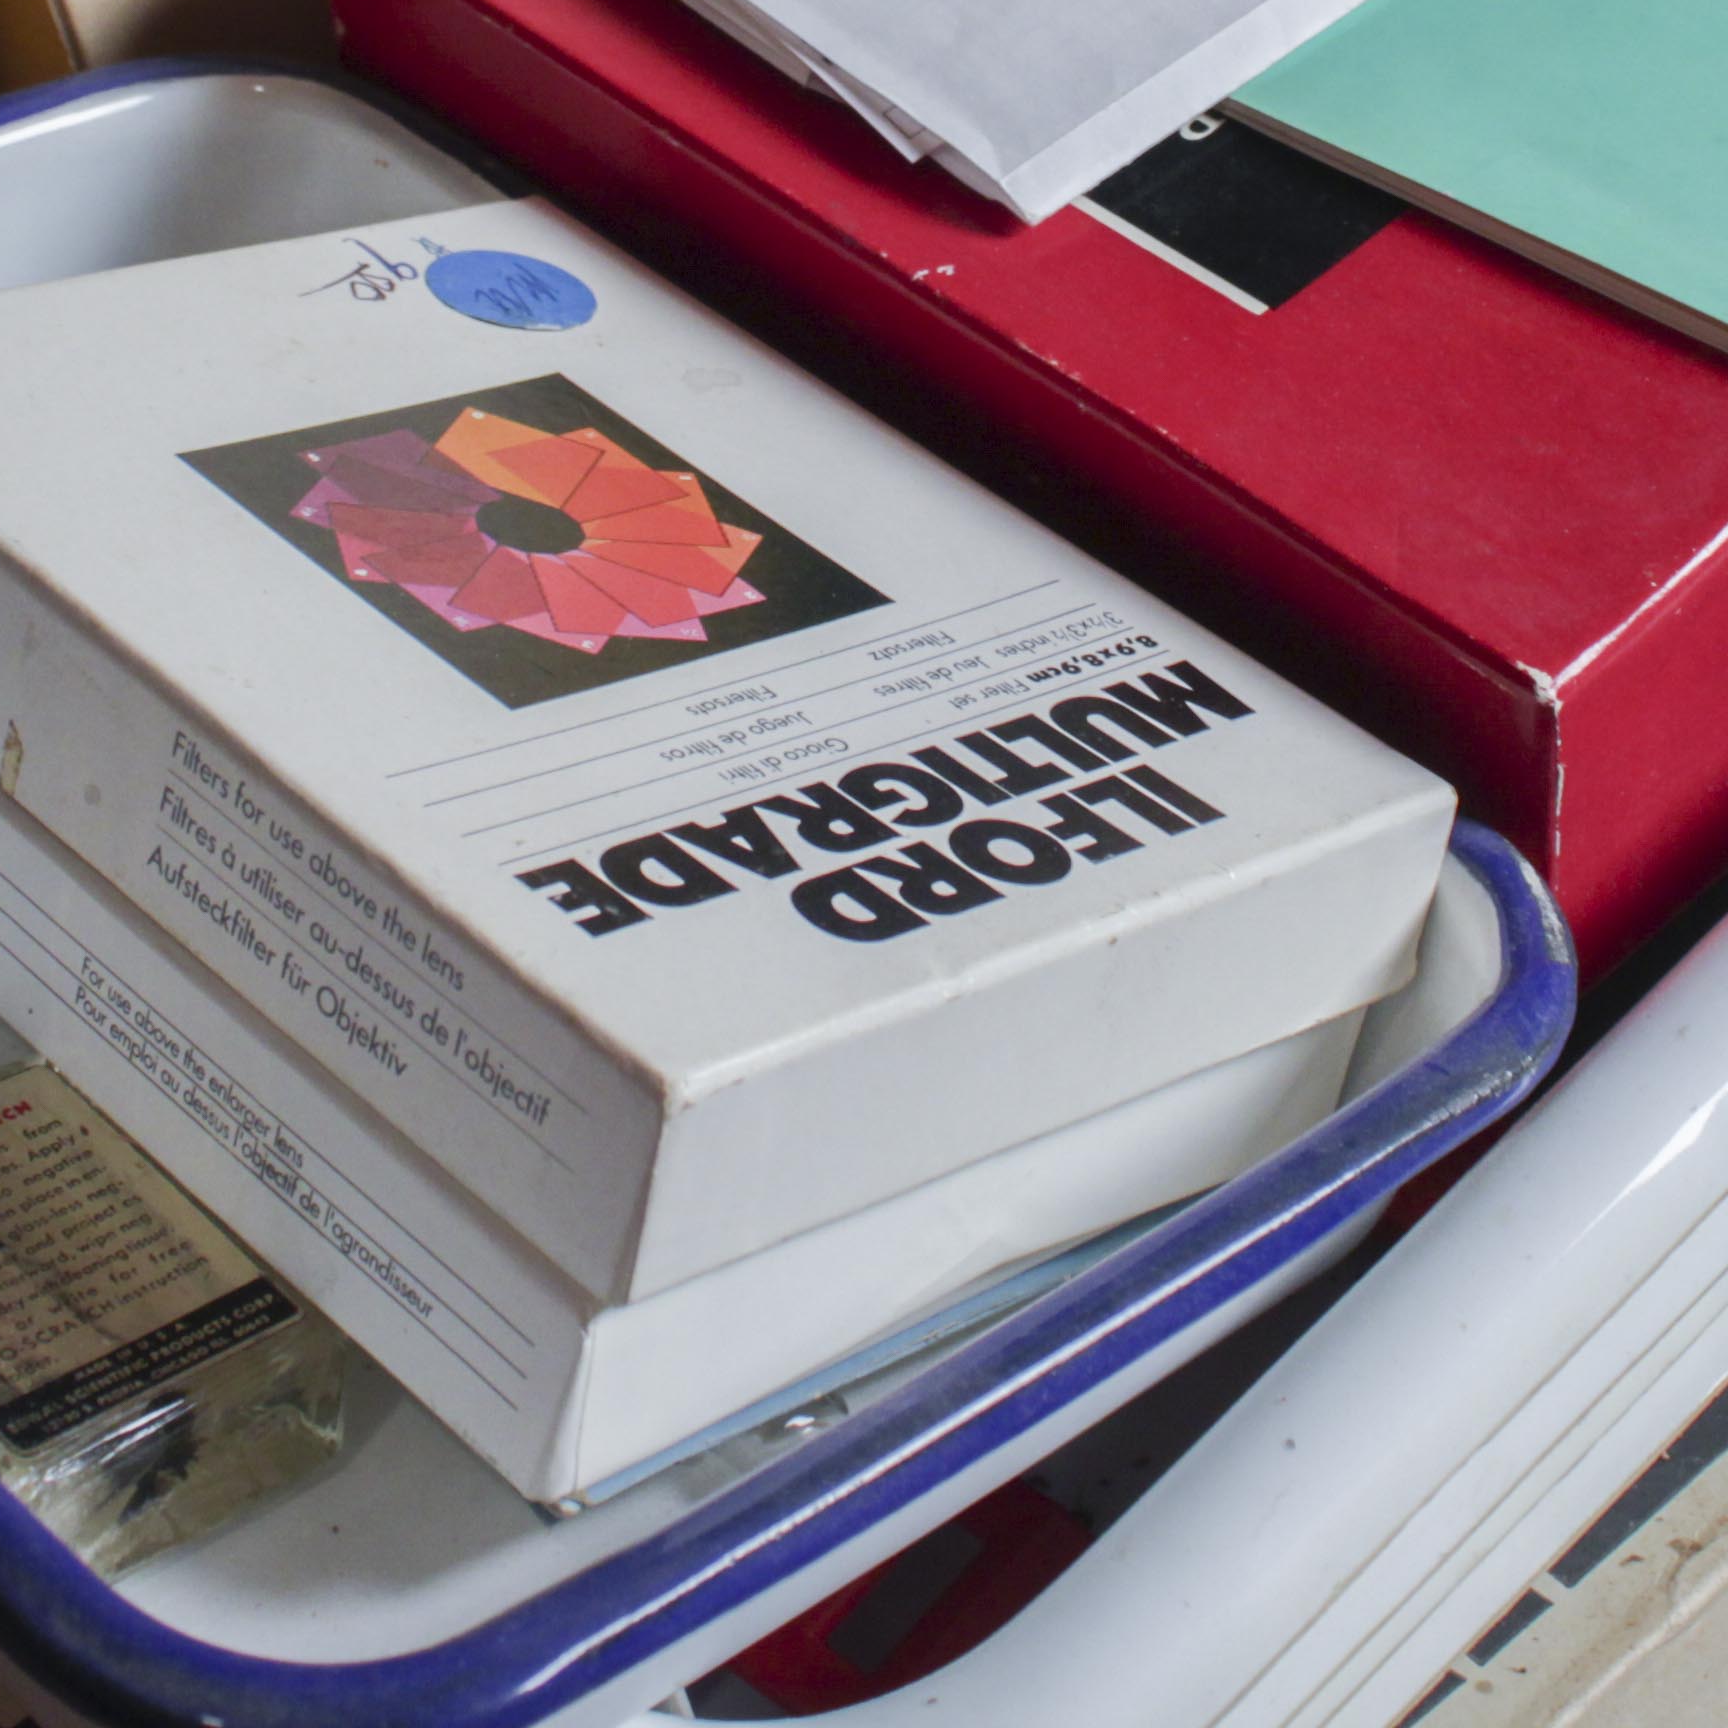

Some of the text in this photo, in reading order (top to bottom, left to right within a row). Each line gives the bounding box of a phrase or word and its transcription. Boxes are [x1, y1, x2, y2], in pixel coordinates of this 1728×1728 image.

[995, 633, 1050, 659] inches
[685, 629, 956, 716] Filtersatz Filtersats
[928, 664, 953, 681] de
[957, 654, 990, 672] Jeu
[872, 672, 928, 699] filtres
[984, 676, 1031, 701] Filter
[948, 692, 978, 712] set
[748, 710, 813, 735] Juego
[659, 738, 725, 763] filtros
[721, 728, 747, 747] de
[783, 736, 849, 762] Gioco
[719, 761, 766, 786] filtri
[764, 752, 780, 770] di
[513, 660, 1257, 939] MULTIGRADE
[172, 730, 465, 992] Filters for use above the lens
[791, 763, 1227, 944] ILFORD
[146, 845, 409, 1078] Aufsteckfilter für Objektiv
[159, 785, 552, 1127] Filtres à utiliser au-dessus de l'objectif
[80, 956, 304, 1170] For use above the enlarger lens
[74, 985, 108, 1026] Pour
[109, 1017, 160, 1075] emploi
[159, 1068, 181, 1095] au
[183, 1082, 231, 1141] dessus
[234, 1129, 301, 1200] l'objectif
[298, 1185, 322, 1220] de
[20, 1116, 63, 1140] from
[23, 1132, 78, 1162] Apply
[17, 1184, 66, 1211] place
[21, 1234, 56, 1255] and
[59, 1205, 120, 1238] project
[107, 1264, 139, 1284] for
[147, 1238, 192, 1264] free
[147, 1315, 232, 1361] PRODUCTS
